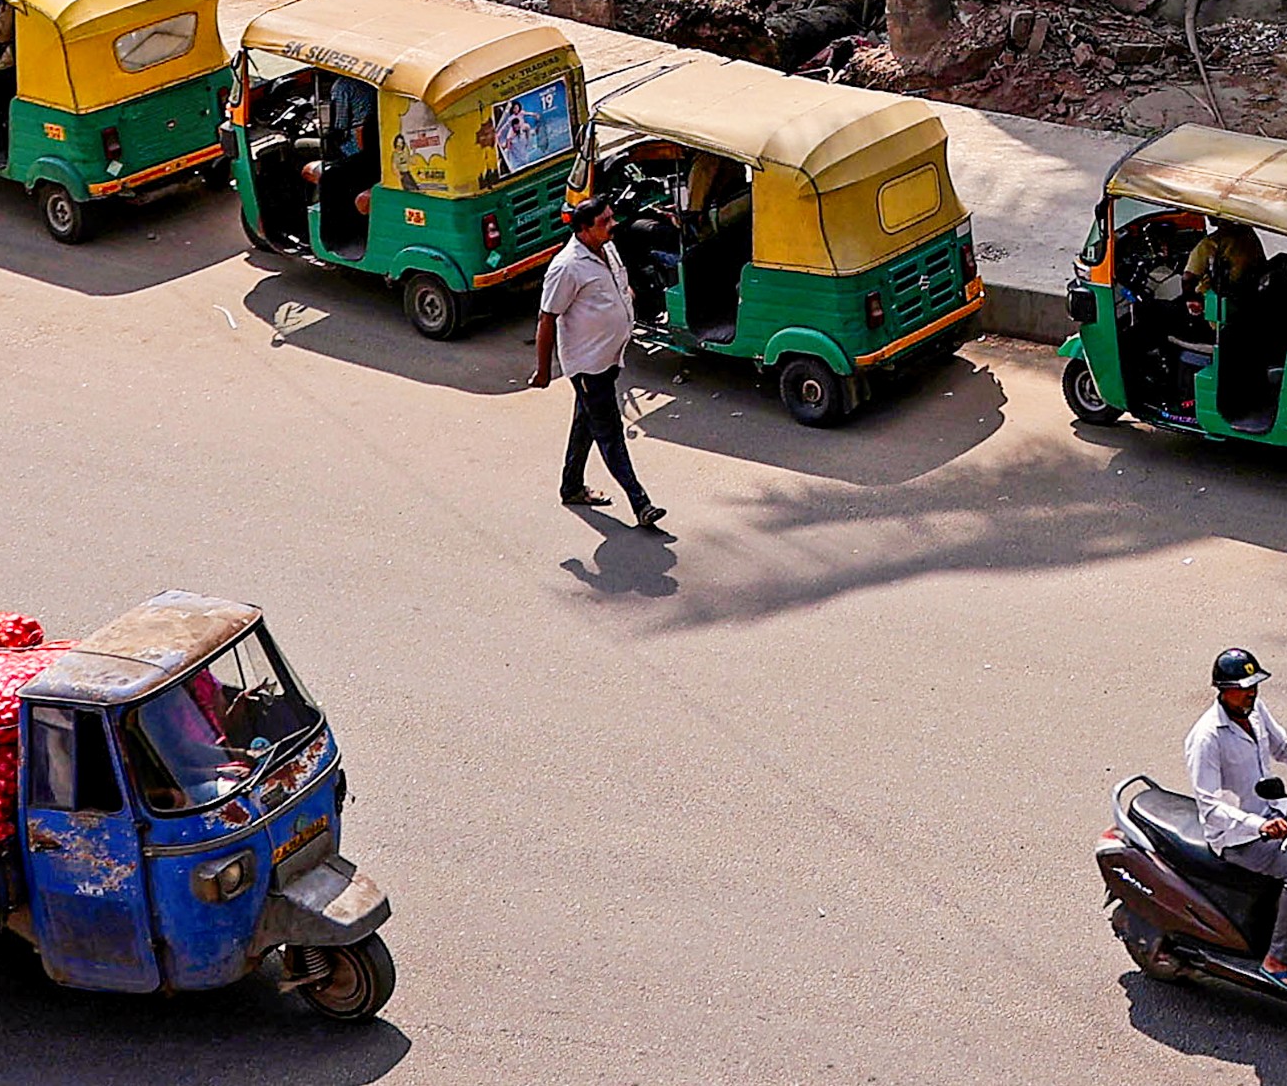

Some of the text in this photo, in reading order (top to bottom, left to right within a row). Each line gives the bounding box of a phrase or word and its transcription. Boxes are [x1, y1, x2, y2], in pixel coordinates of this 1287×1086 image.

[282, 40, 395, 86] SK SUPER TMT
[520, 55, 561, 77] TRADERS
[540, 94, 554, 110] 19
